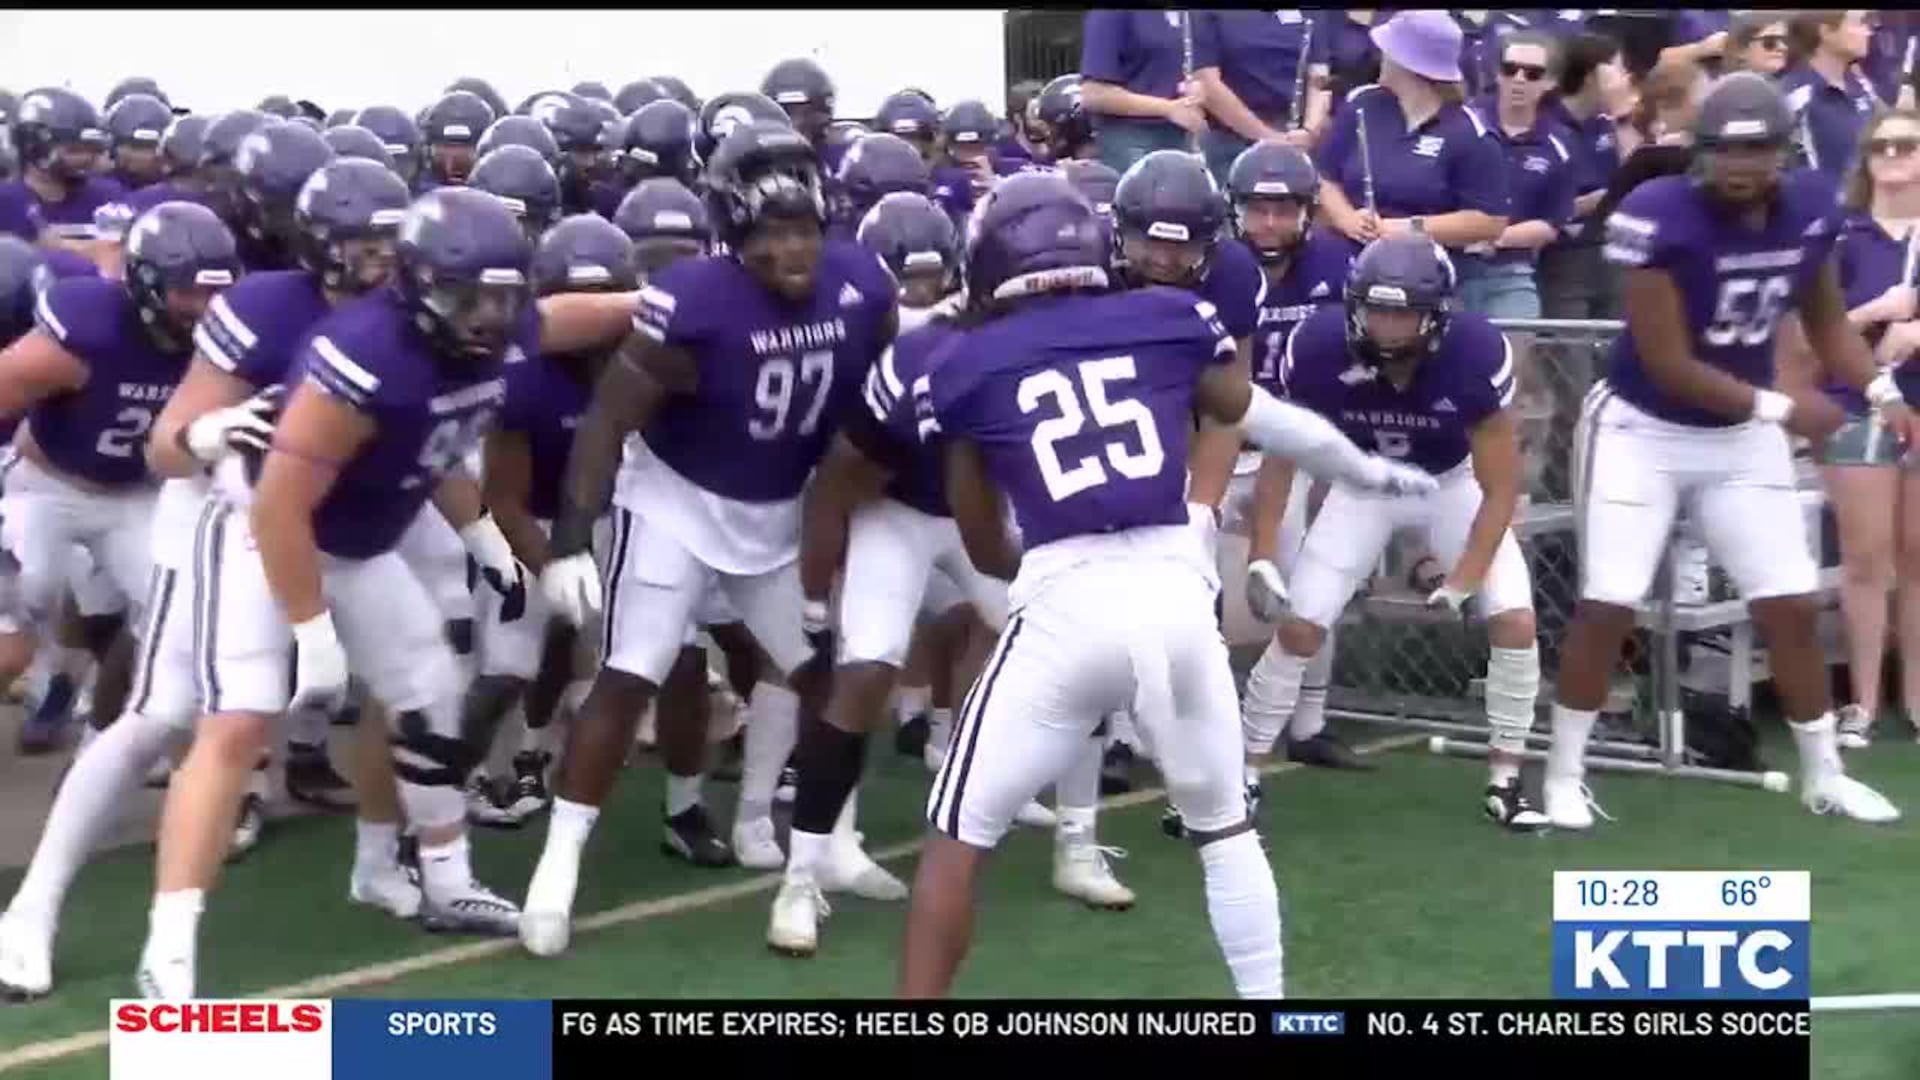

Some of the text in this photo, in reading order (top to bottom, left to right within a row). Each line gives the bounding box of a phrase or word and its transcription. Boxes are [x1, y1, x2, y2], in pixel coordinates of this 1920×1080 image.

[750, 317, 846, 354] WARRIORS
[748, 349, 834, 440] 97
[1017, 355, 1165, 502] 25
